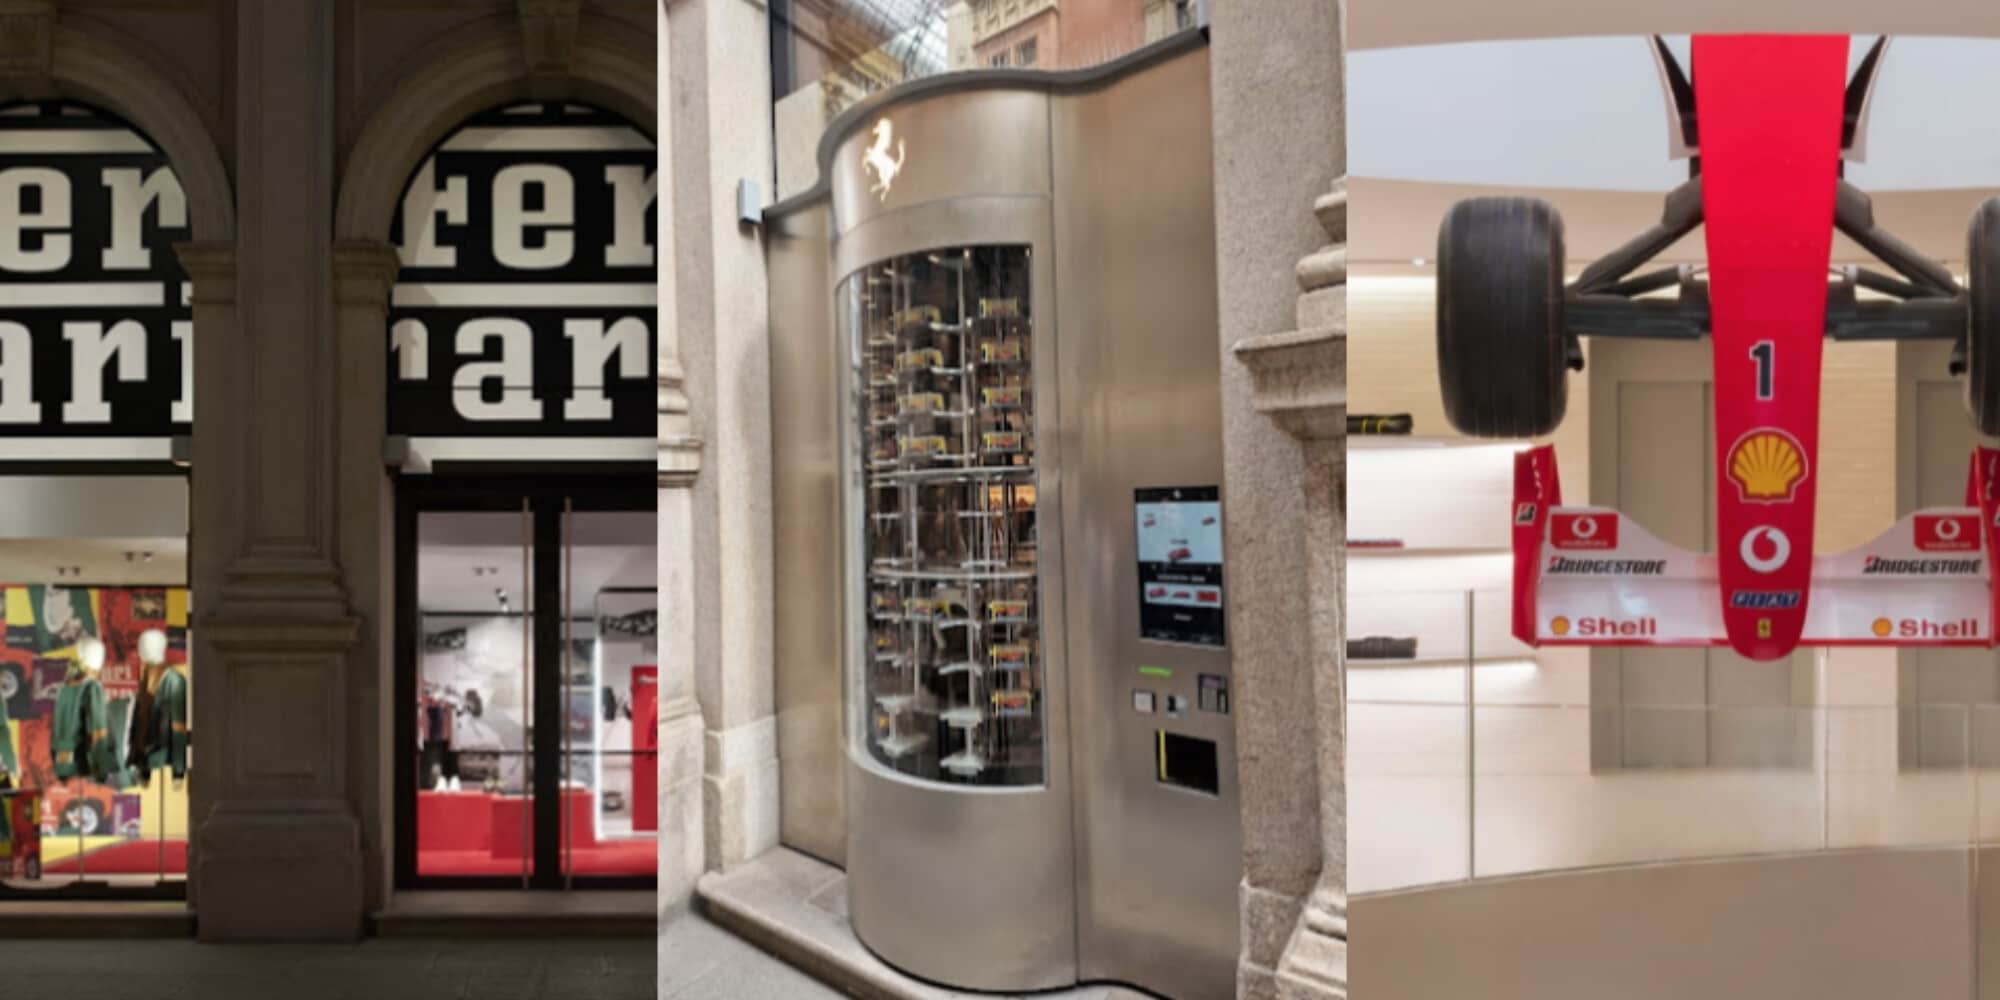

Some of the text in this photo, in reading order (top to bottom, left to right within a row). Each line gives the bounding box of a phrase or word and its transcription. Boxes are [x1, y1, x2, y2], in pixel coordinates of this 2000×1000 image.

[1749, 340, 1774, 400] 1
[1547, 556, 1666, 575] BRIDGESTONE
[1863, 555, 1983, 574] BRIDGESTONE
[1578, 617, 1656, 636] Shell
[1899, 618, 1978, 637] Shell
